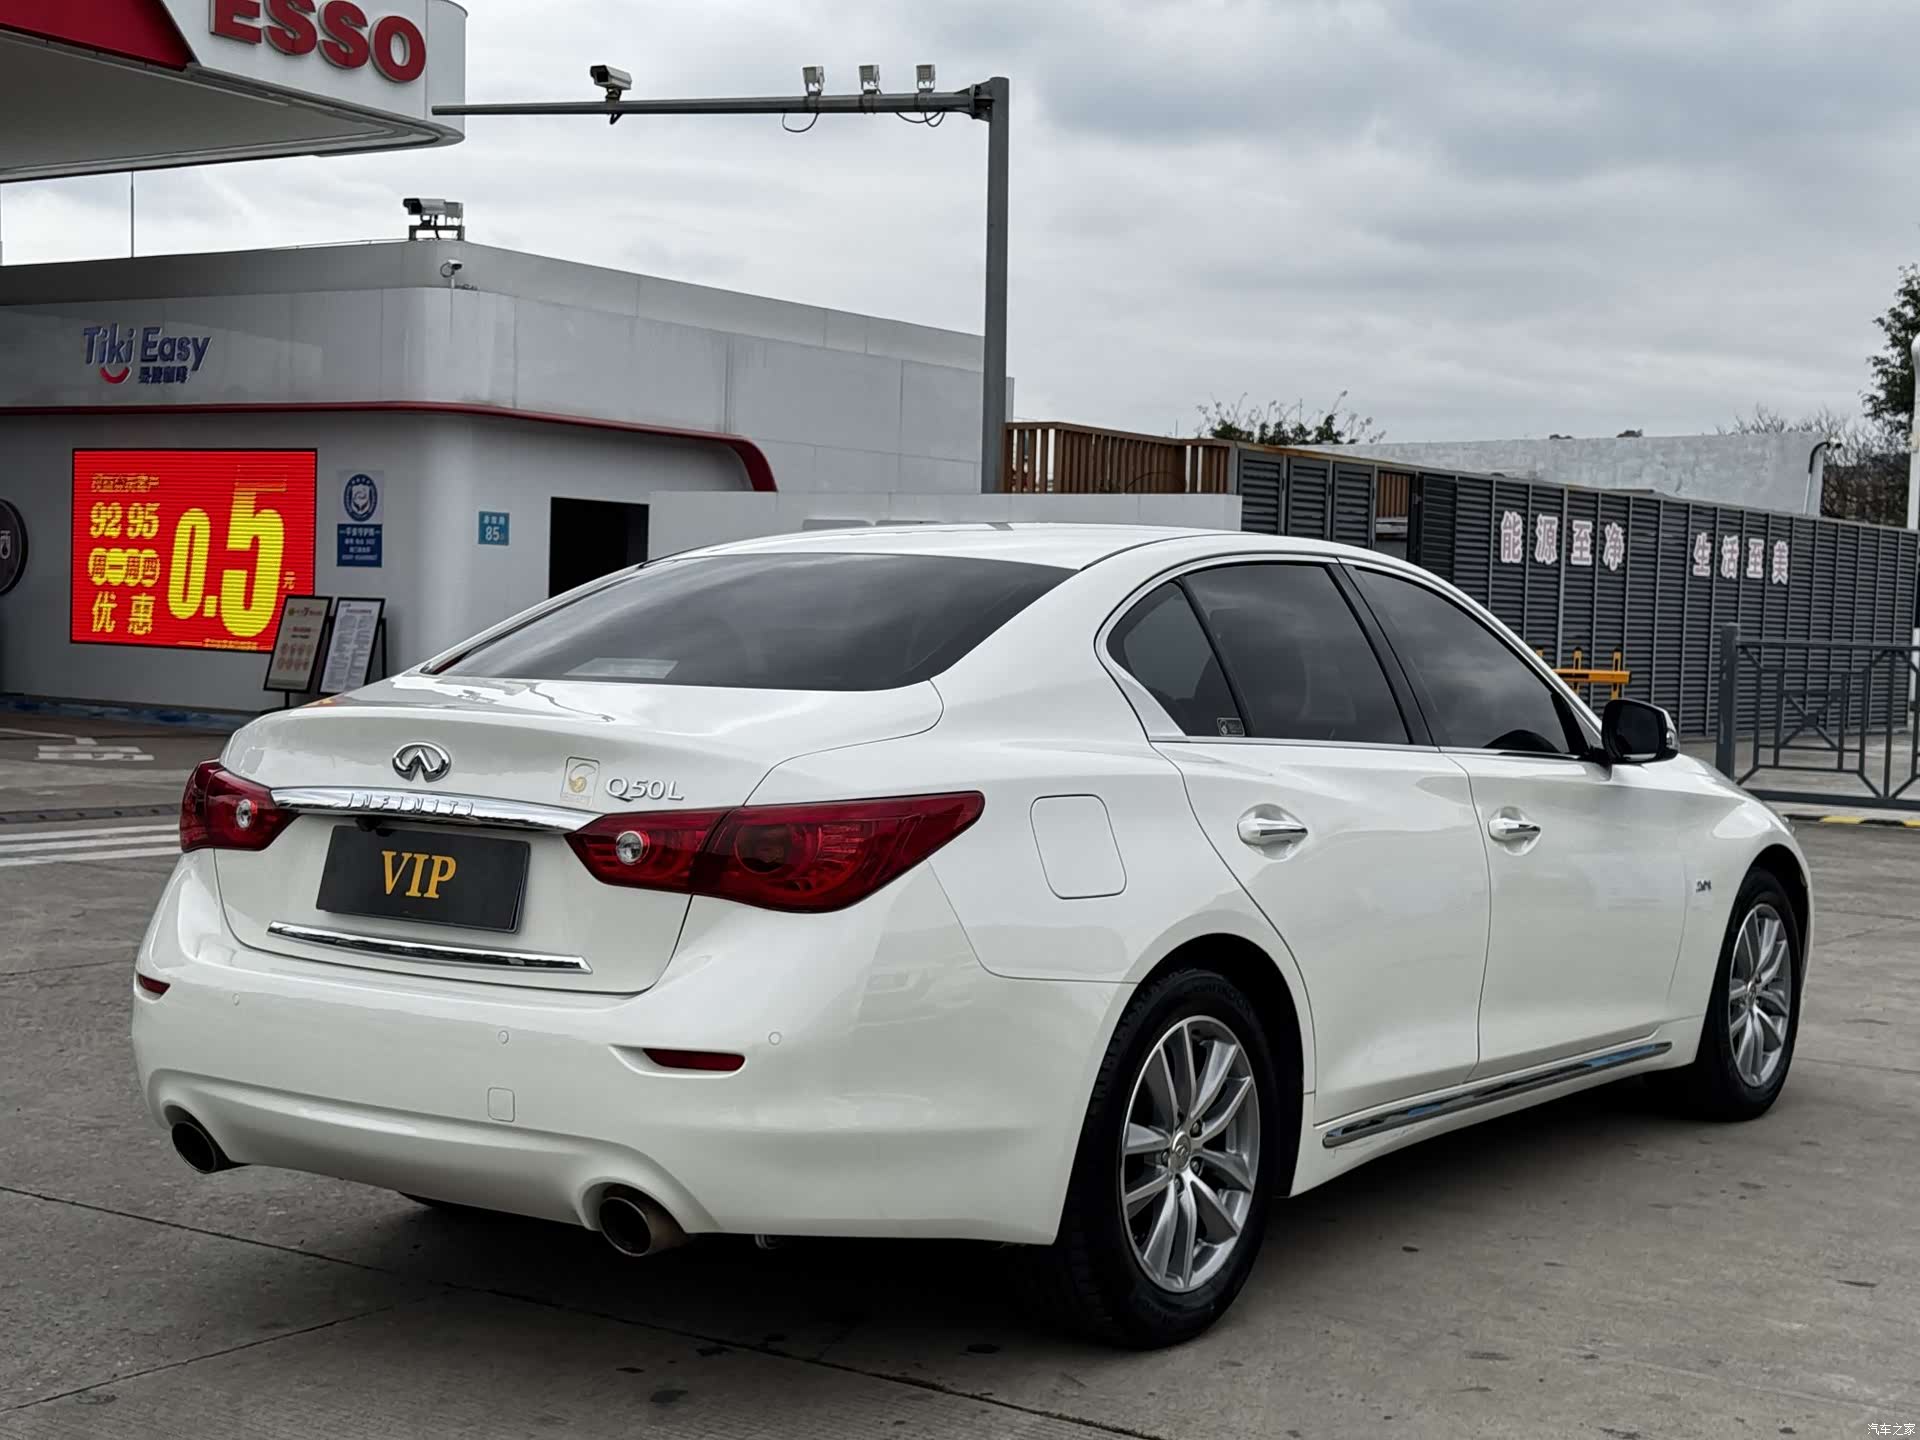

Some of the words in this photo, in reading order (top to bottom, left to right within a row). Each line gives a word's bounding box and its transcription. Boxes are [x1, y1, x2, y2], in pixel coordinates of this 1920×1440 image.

[209, 0, 426, 82] ESSO
[84, 323, 134, 365] Tiki
[140, 326, 211, 372] Easy
[90, 502, 121, 538] 92
[127, 503, 160, 539] 95
[1501, 511, 1624, 571] 能源至净
[168, 468, 288, 637] 0.5
[283, 571, 296, 590] 元
[1693, 532, 1788, 585] 生活至美
[92, 591, 156, 635] 优惠
[349, 793, 474, 816] INFINITI
[605, 777, 685, 802] Q50L
[382, 850, 457, 899] VIP
